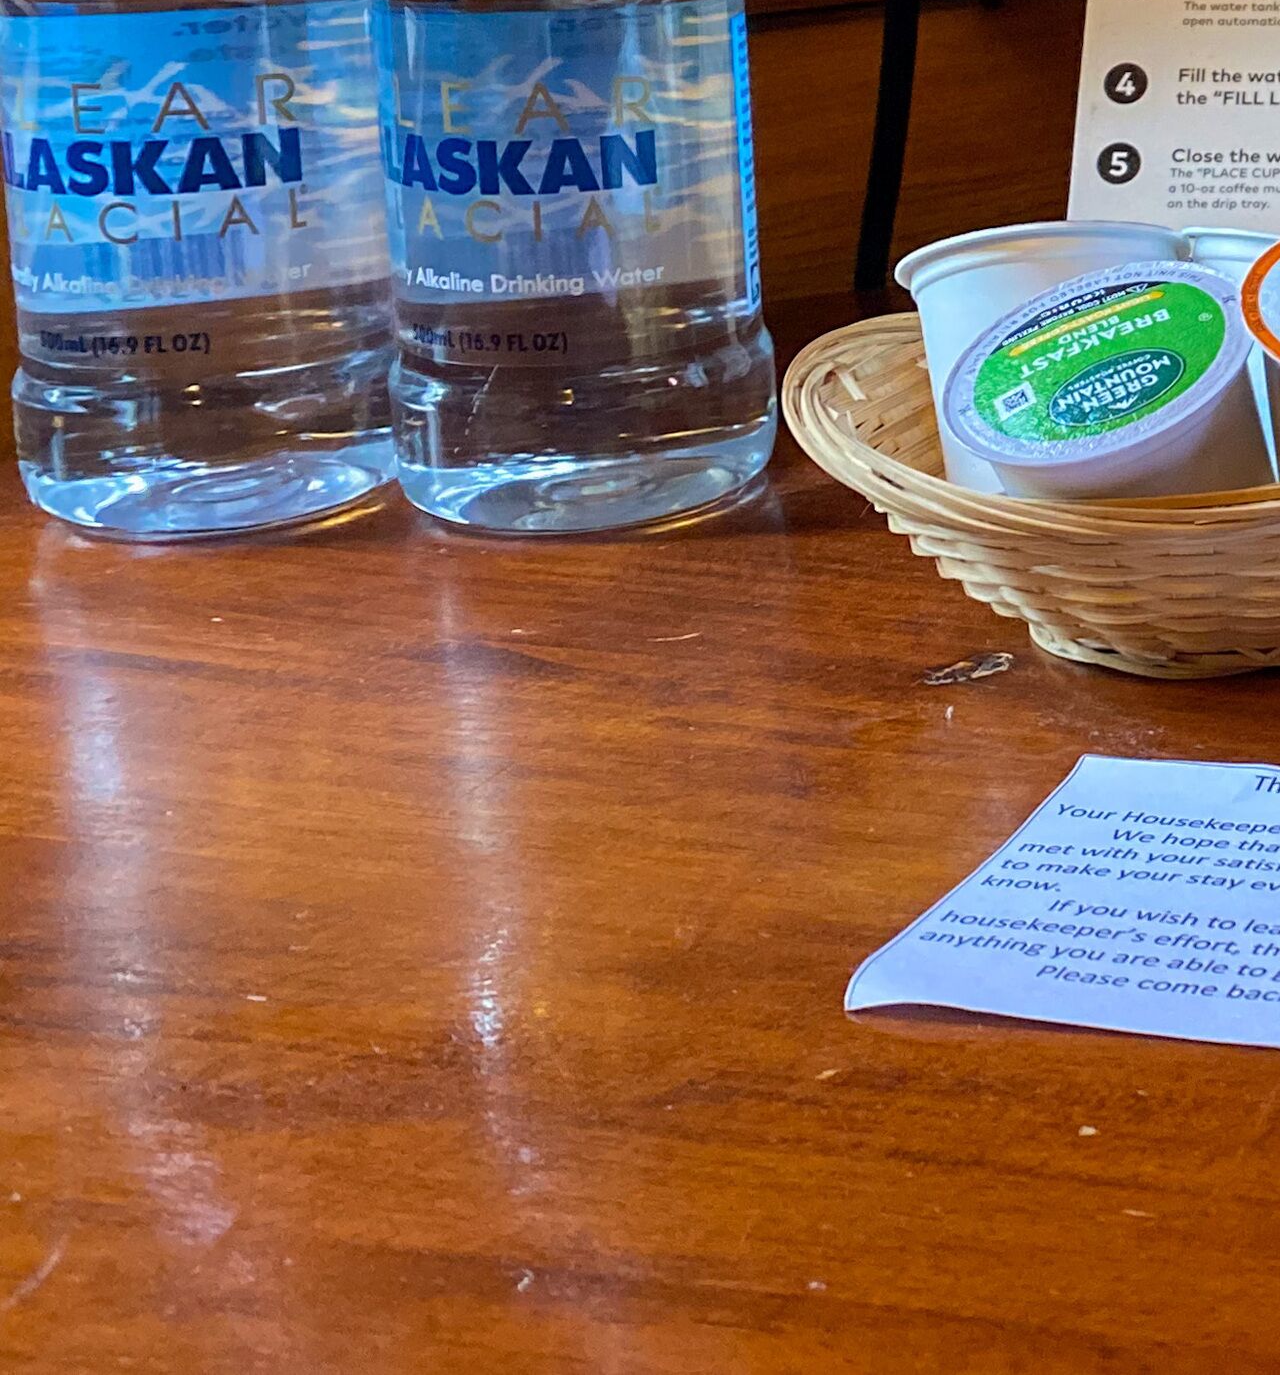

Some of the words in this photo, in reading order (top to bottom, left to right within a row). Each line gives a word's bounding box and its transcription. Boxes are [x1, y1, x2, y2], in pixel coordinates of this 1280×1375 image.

[1183, 1, 1207, 12] The
[1210, 2, 1248, 12] water
[1251, 2, 1279, 12] tank
[1182, 17, 1213, 28] open
[1177, 68, 1205, 83] Fill
[1212, 69, 1243, 84] the
[1176, 91, 1208, 106] the
[1171, 148, 1223, 164] Close
[1230, 148, 1261, 164] the
[416, 267, 484, 293] Alkaline
[491, 274, 584, 295] Drinking
[592, 266, 665, 288] Water
[1058, 315, 1120, 344] BLEND
[1021, 309, 1170, 379] BREAKFAST
[1058, 355, 1171, 411] MOUNTAIN
[1083, 374, 1158, 412] GREEN
[1055, 802, 1116, 822] Your
[1017, 841, 1075, 856] met
[1080, 842, 1141, 861] with
[1145, 850, 1208, 868] your
[1111, 828, 1156, 845] We
[1160, 830, 1230, 854] hope
[979, 873, 1062, 893] know.
[1000, 858, 1029, 871] to
[1036, 859, 1111, 878] make
[1115, 867, 1181, 886] your
[1186, 869, 1244, 891] stay
[1048, 898, 1070, 913] If
[1074, 902, 1129, 921] you
[1135, 906, 1200, 925] wish
[1205, 913, 1237, 931] to
[919, 928, 1046, 958] anything
[1051, 945, 1106, 963] you
[1111, 949, 1161, 967] are
[1166, 951, 1228, 975] able
[1236, 962, 1266, 979] to
[1153, 930, 1239, 955] effort,
[1036, 964, 1131, 988] Please
[1136, 978, 1218, 997] come
